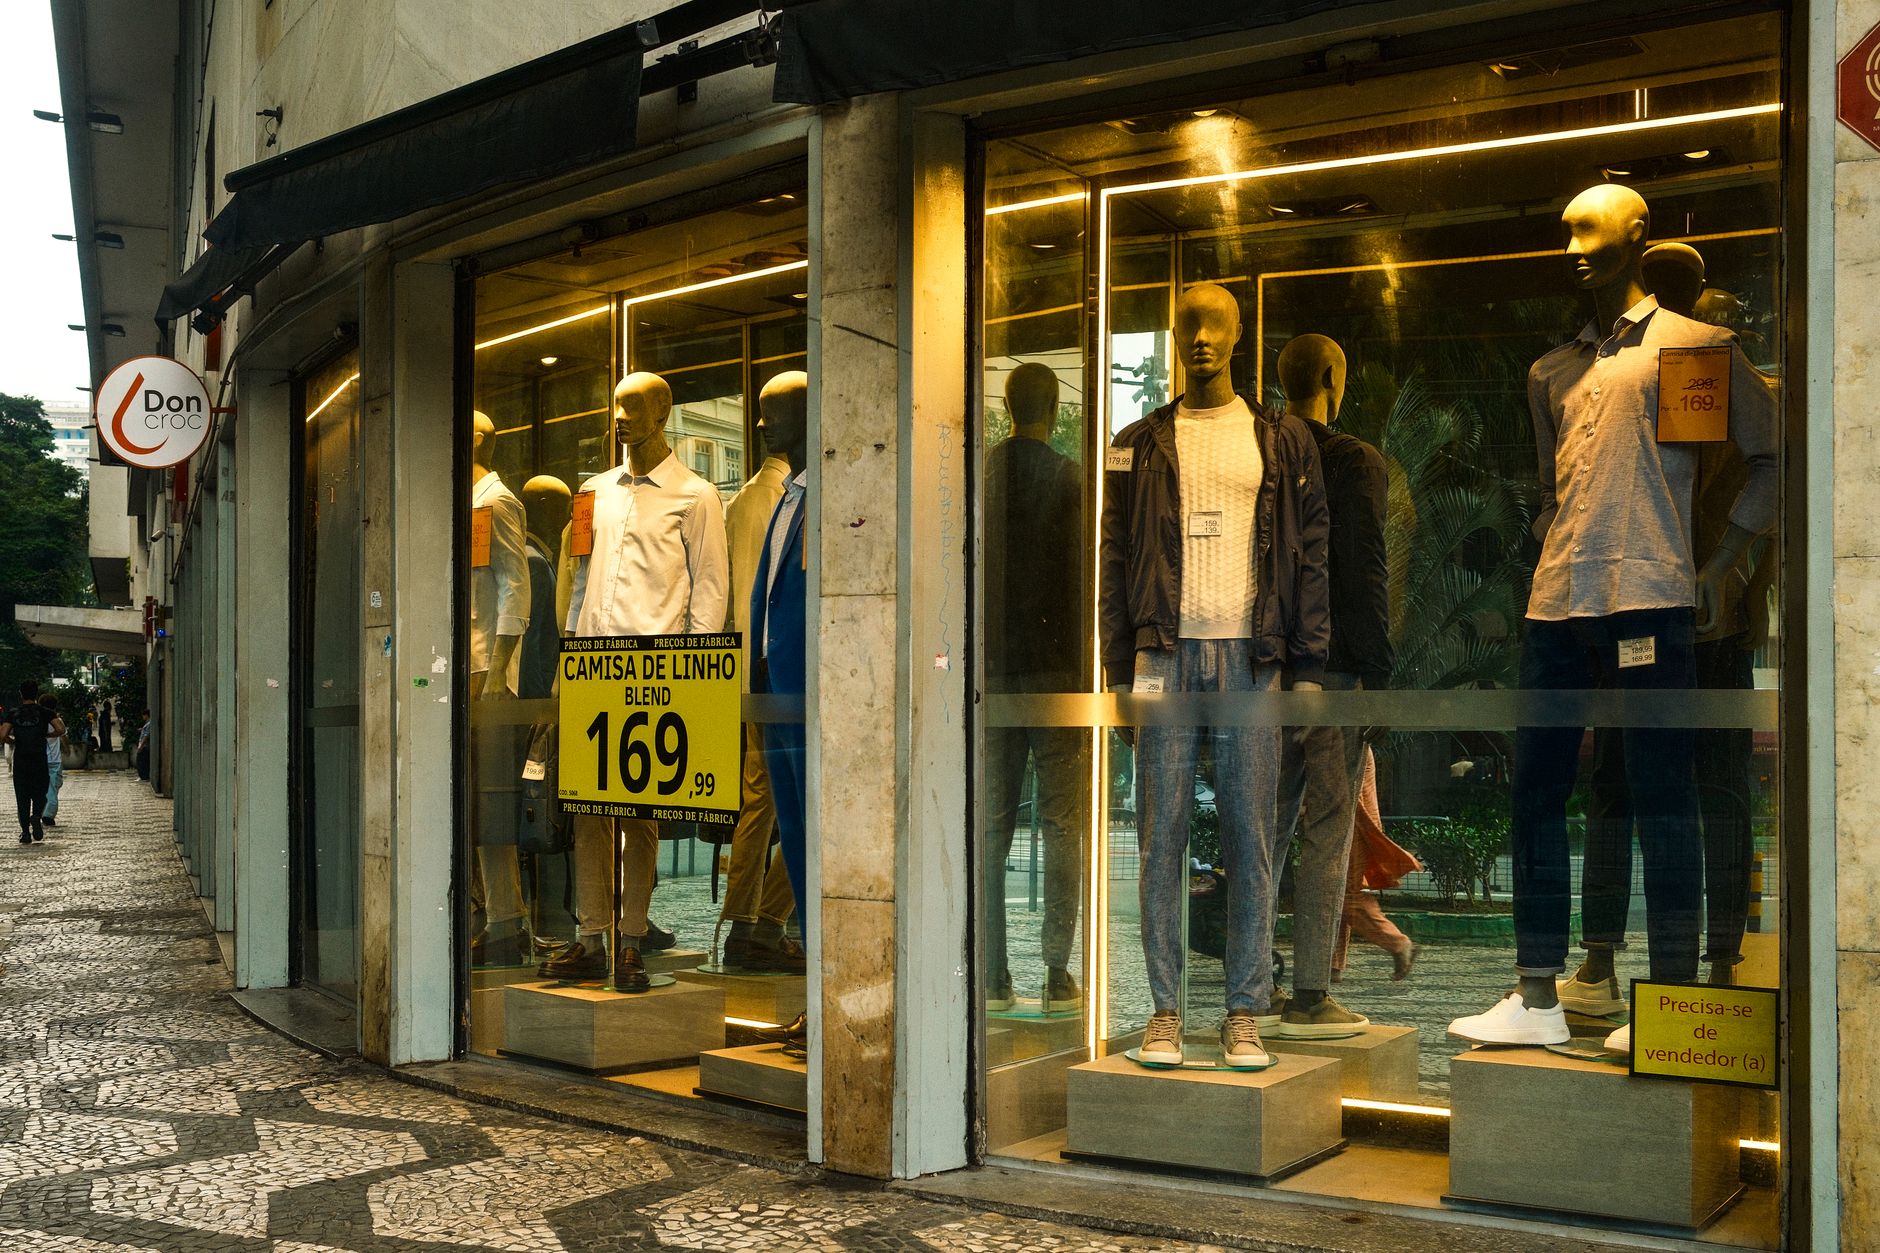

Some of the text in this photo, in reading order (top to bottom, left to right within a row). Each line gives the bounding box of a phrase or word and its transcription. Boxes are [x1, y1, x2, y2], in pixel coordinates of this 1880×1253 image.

[144, 390, 201, 412] Don
[1680, 395, 1714, 411] 169
[144, 414, 201, 429] croc
[1109, 457, 1131, 465] 179,99
[564, 637, 638, 651] PREÇOS DE FÁBRICA
[654, 635, 736, 649] PREÇOS DE FÁBRICA
[1632, 654, 1652, 662] 169,99
[564, 653, 736, 681] CAMISA DE LINHO
[625, 686, 671, 706] BLEND
[586, 711, 689, 796] 169
[563, 803, 637, 817] PREÇOS DE FÁBRICA
[652, 809, 734, 825] PREÇOS DE FÁBRICA
[1659, 996, 1753, 1018] Precisa-se
[1693, 1023, 1717, 1040] de
[1645, 1048, 1766, 1073] vendedor (a)
